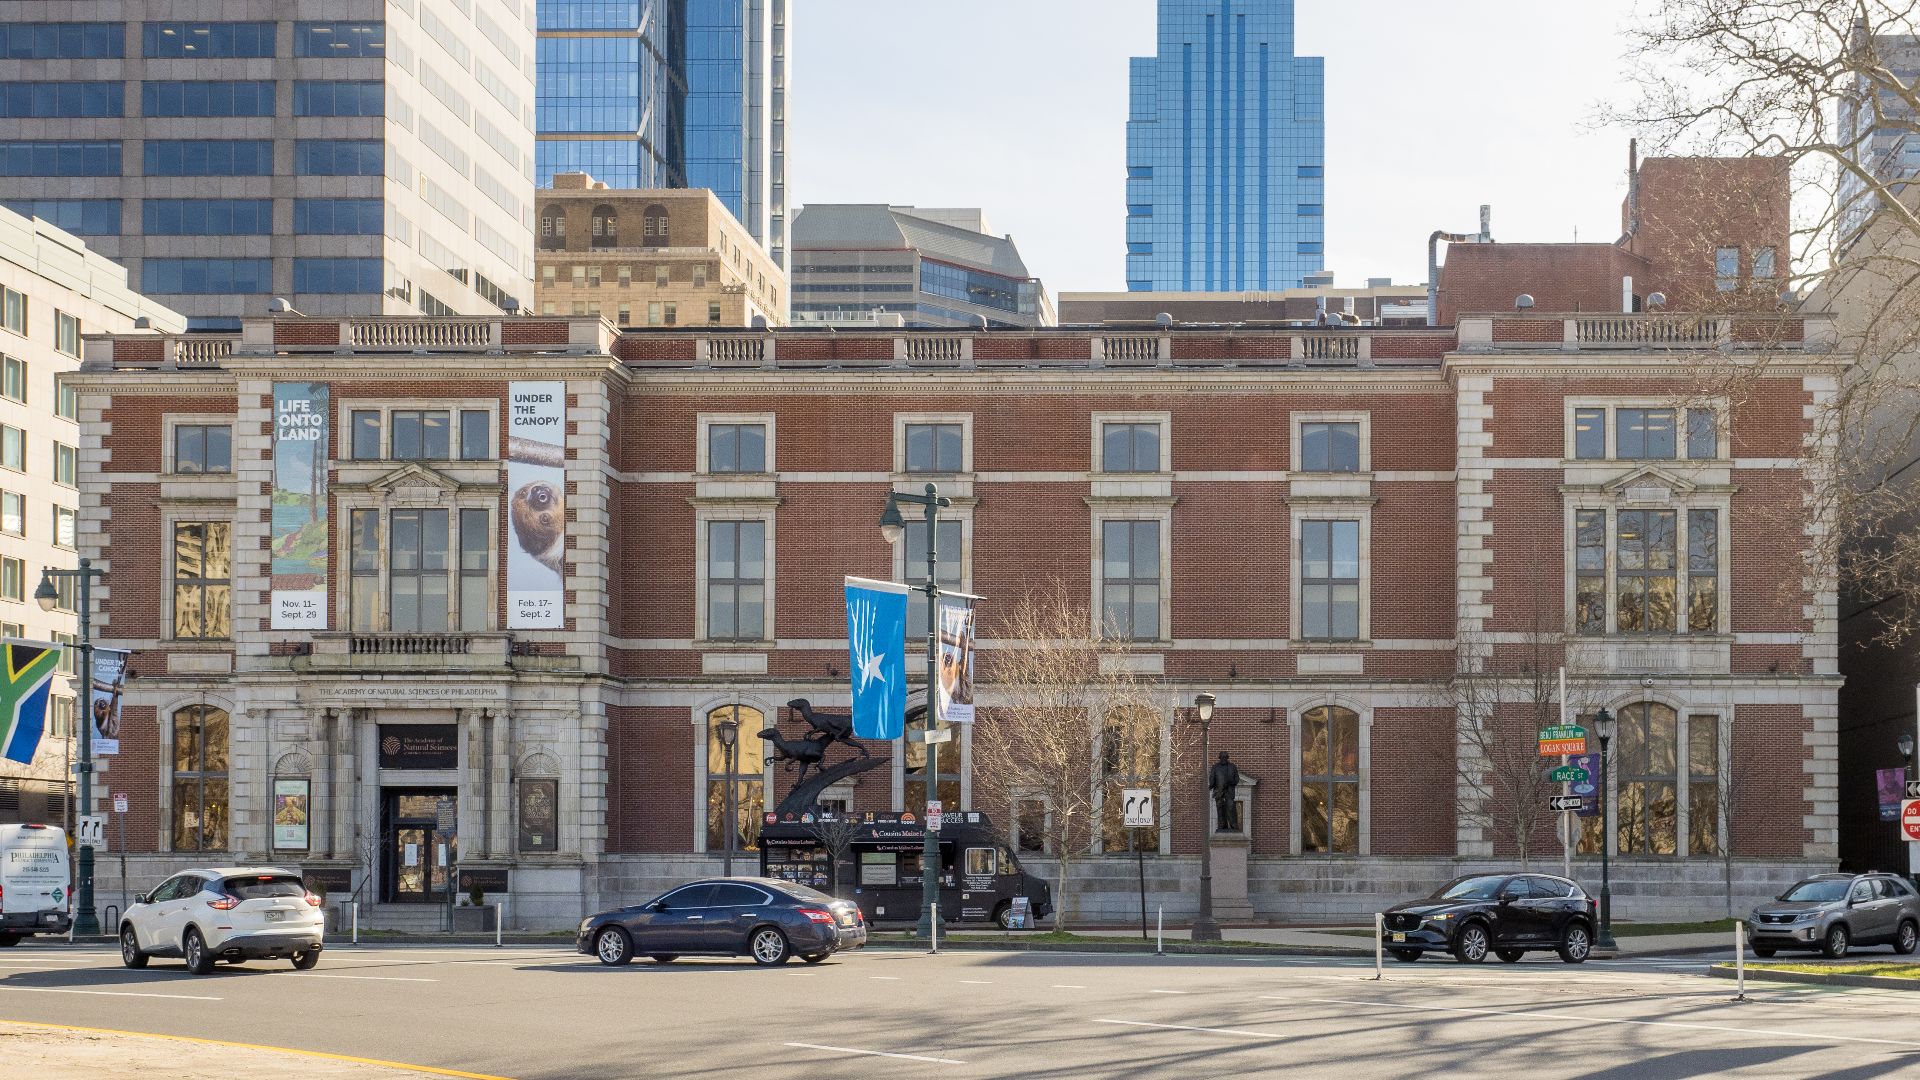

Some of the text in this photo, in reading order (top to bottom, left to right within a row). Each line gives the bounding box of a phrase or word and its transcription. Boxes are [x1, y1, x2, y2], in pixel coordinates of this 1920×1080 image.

[514, 394, 553, 403] UNDER
[279, 399, 311, 413] LIFE
[513, 405, 536, 415] THE
[278, 413, 323, 427] ONTO
[514, 416, 560, 426] CANOPY
[278, 427, 321, 441] LAND
[282, 600, 301, 608] Nov.
[518, 599, 537, 607] Feb.
[281, 611, 317, 620] Sept. 29
[520, 610, 551, 620] Sept. 2
[319, 688, 498, 696] THE ACADEMY OF NATURAL SCIENCES OF PHILADELPHIA
[1553, 729, 1574, 739] FRANKLIN
[1540, 742, 1585, 754] LOGAN SQUARE
[1556, 771, 1575, 781] RACE
[1907, 807, 1917, 815] DO
[1909, 825, 1920, 833] EN
[11, 852, 60, 864] PHILADELPHIA
